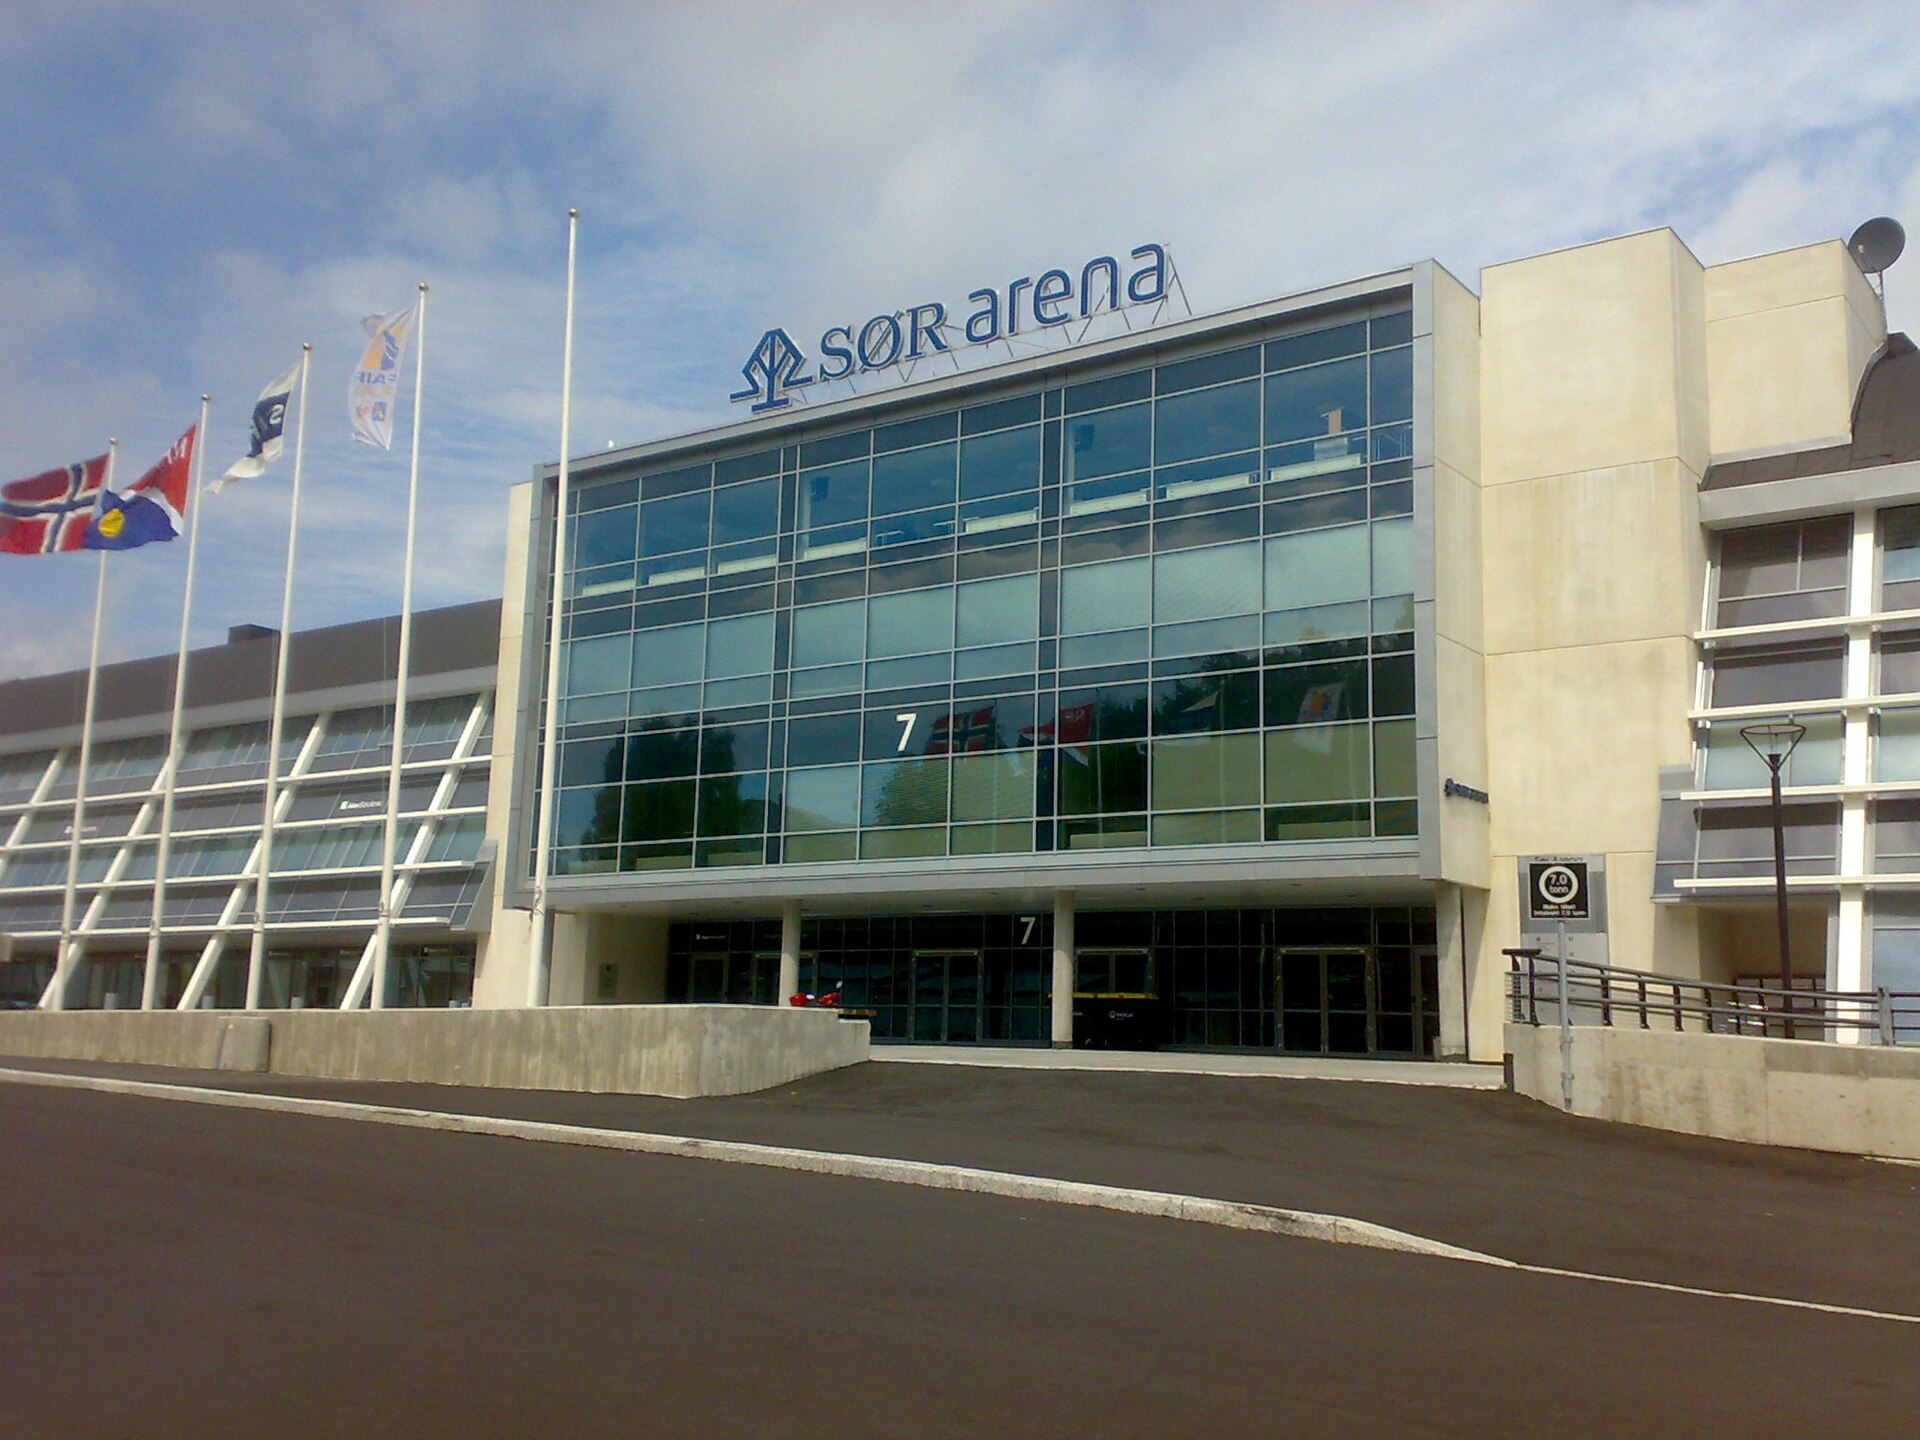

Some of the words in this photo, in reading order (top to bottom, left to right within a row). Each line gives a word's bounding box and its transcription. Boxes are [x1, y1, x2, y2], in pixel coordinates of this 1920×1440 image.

[818, 301, 949, 383] SØR
[964, 242, 1167, 344] arena
[895, 712, 917, 752] 7
[1020, 916, 1036, 945] 7
